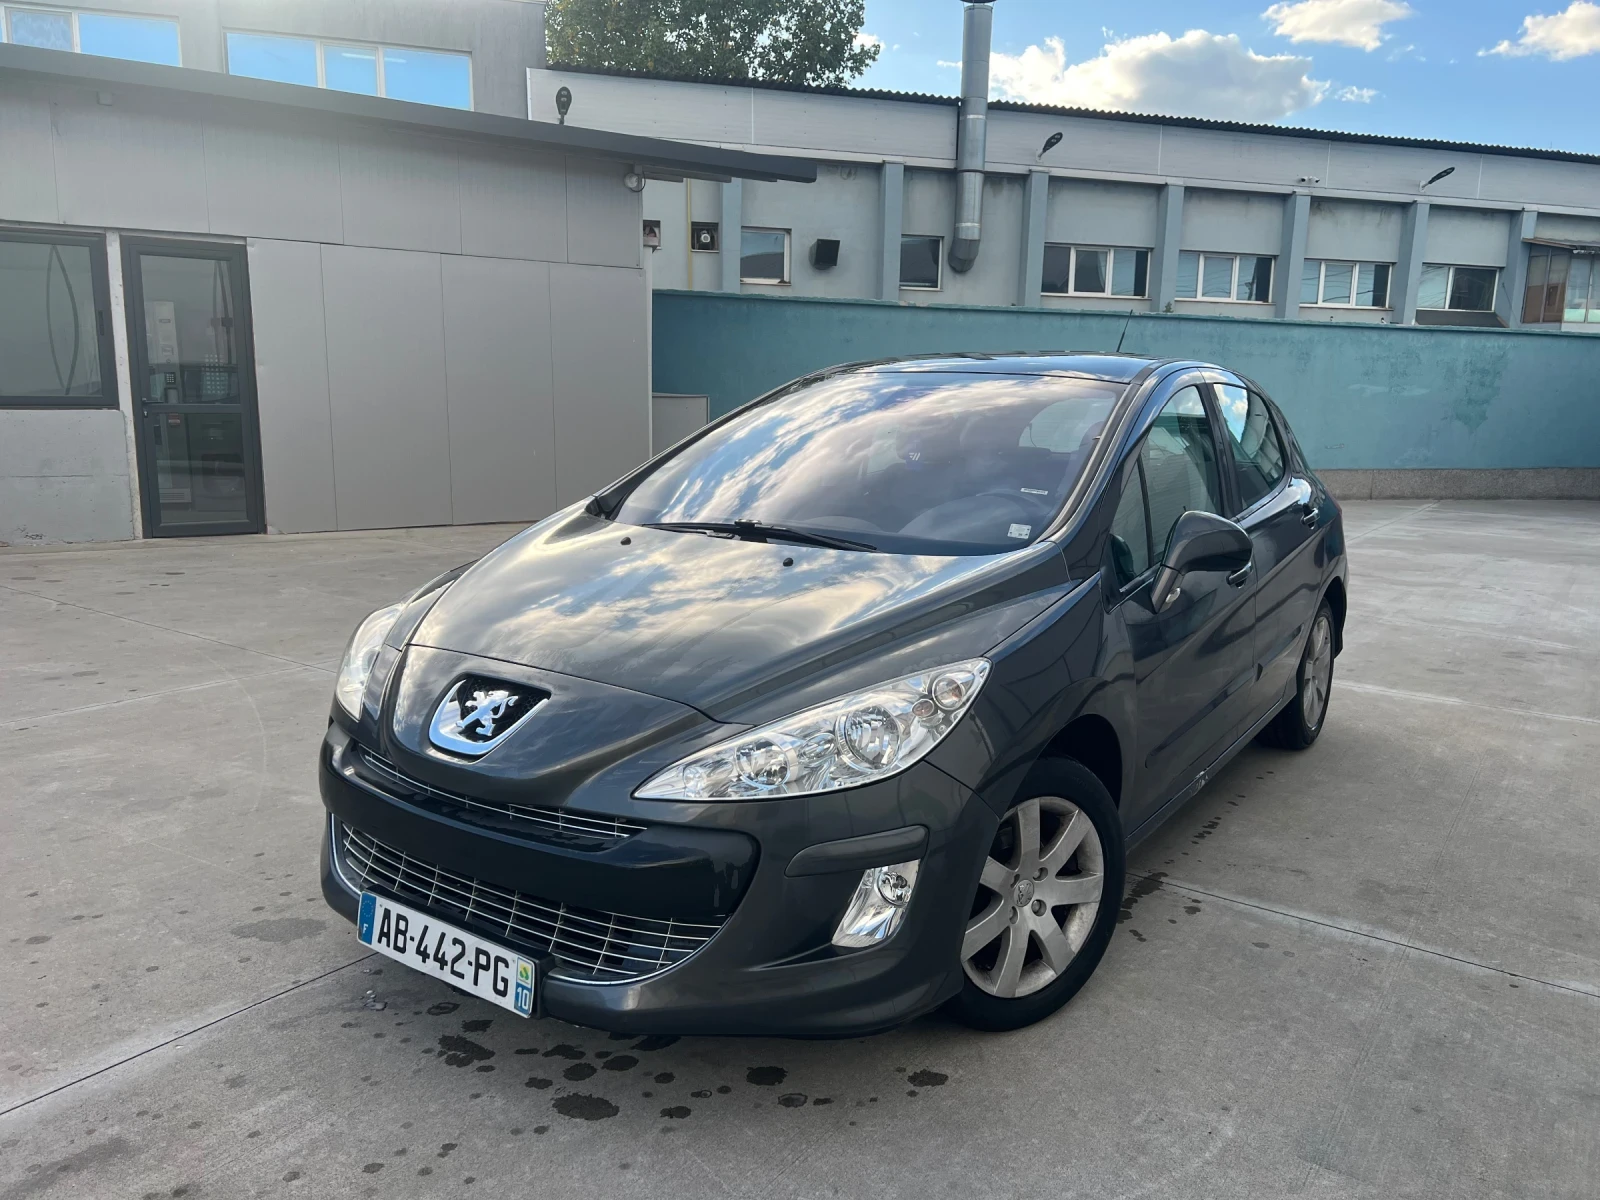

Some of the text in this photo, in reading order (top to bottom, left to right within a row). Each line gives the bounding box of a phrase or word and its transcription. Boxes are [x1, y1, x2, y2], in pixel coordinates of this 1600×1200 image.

[362, 923, 369, 934] F
[377, 907, 510, 998] AB-442-PG
[516, 986, 529, 1010] 10
